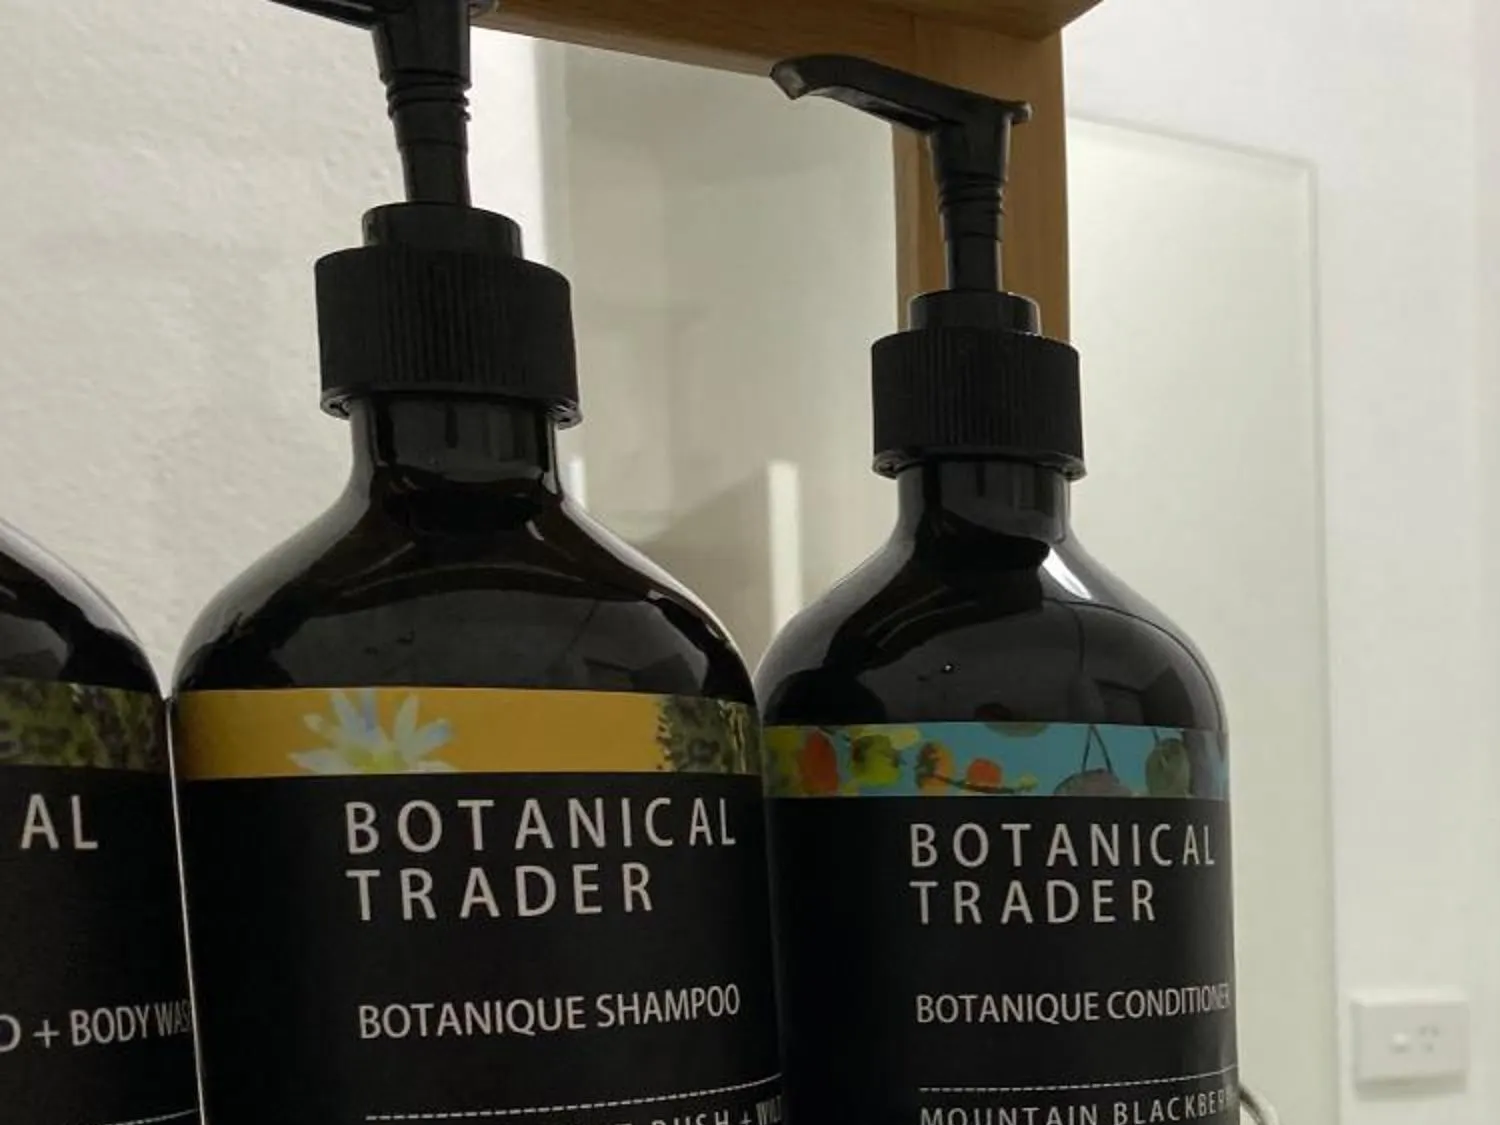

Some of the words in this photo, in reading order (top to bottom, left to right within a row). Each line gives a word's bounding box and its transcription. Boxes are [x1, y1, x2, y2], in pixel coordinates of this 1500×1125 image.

[344, 798, 737, 855] BOTANICAL
[909, 823, 1216, 868] BOTANICAL
[345, 862, 653, 921] TRADER
[909, 879, 1156, 925] TRADER
[69, 1004, 150, 1047] BODY
[154, 998, 193, 1037] WAS
[358, 995, 586, 1040] BOTANIQUE
[596, 983, 740, 1030] SHAMPOO
[916, 991, 1100, 1025] BOTANIQUE
